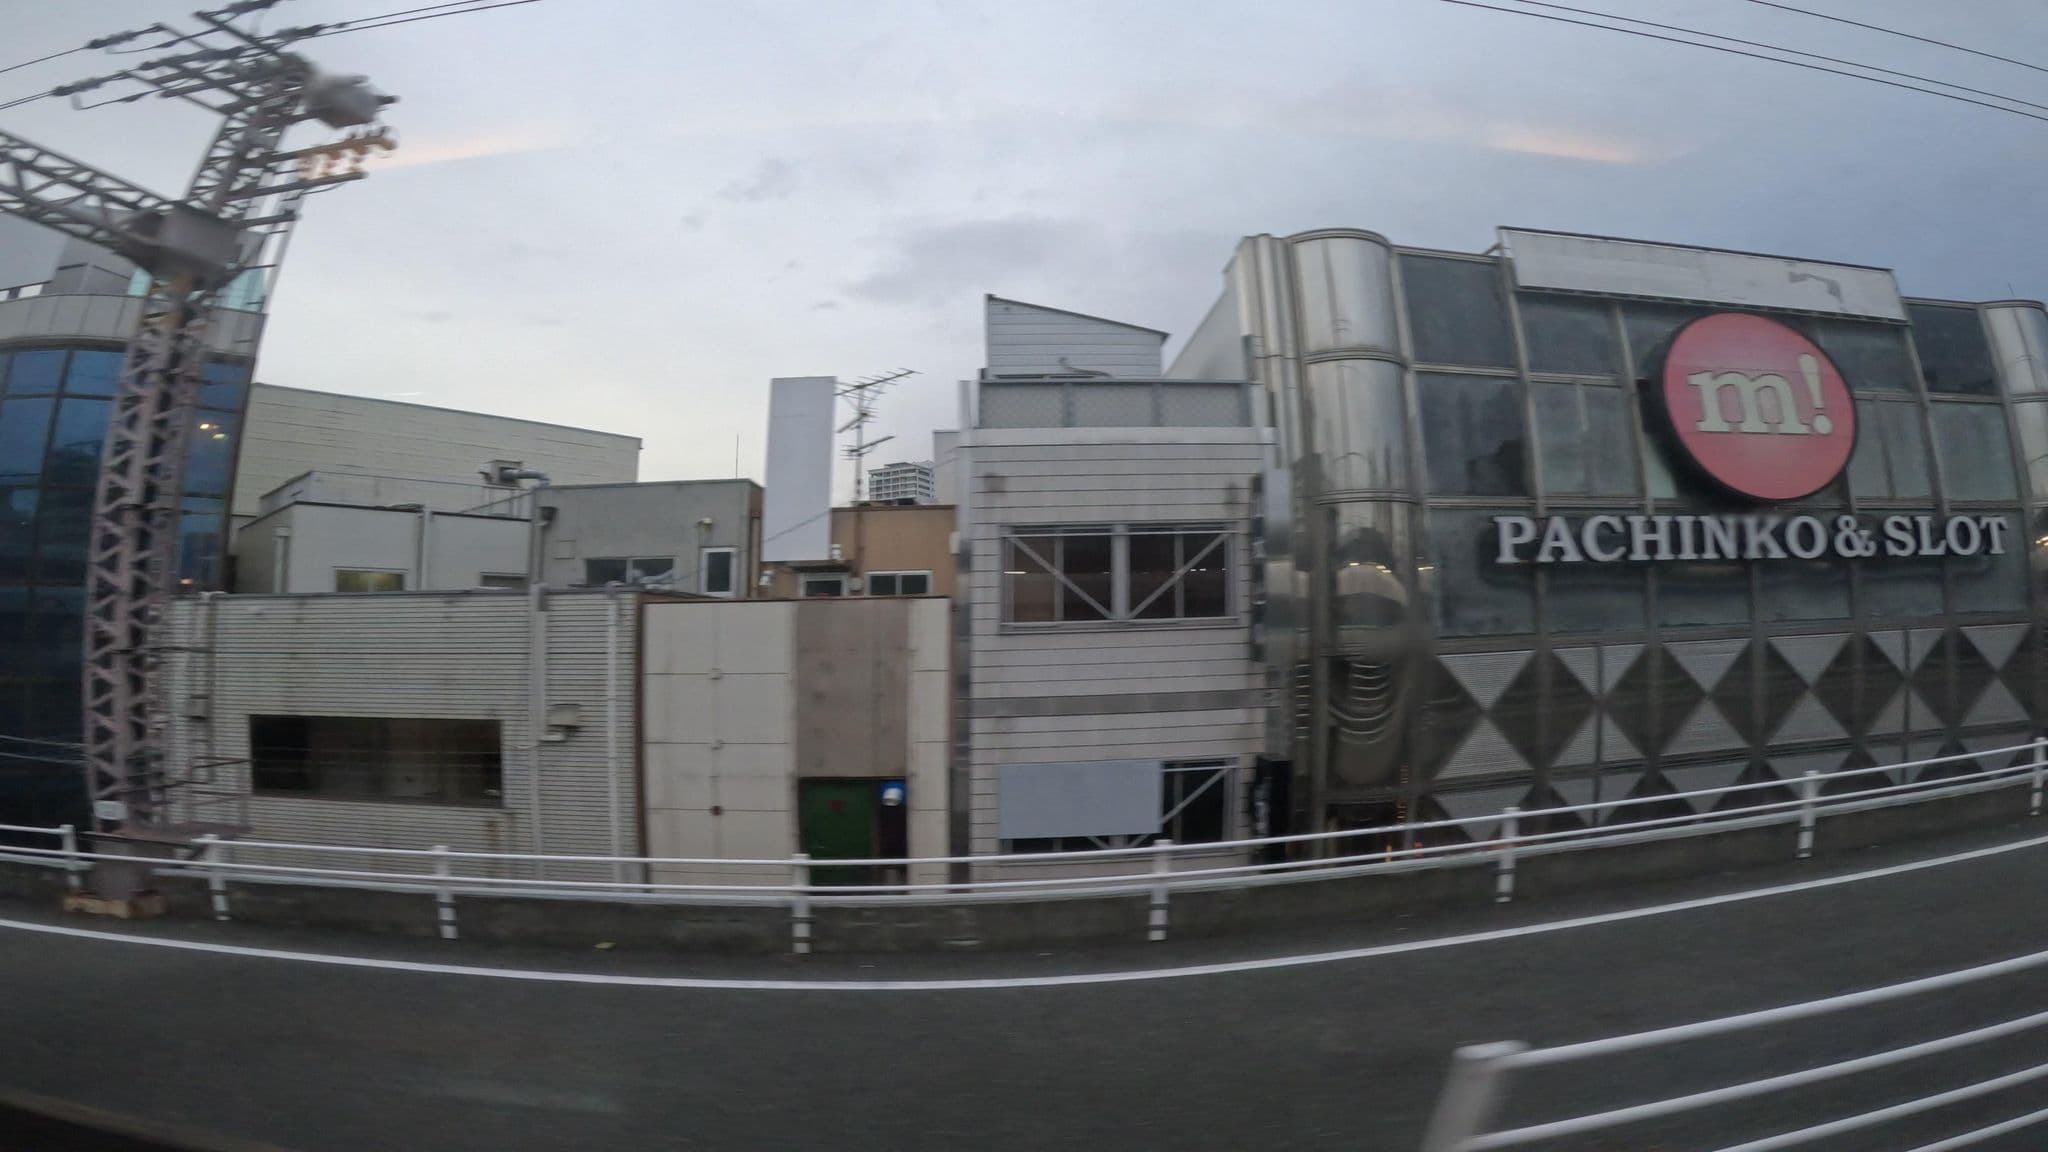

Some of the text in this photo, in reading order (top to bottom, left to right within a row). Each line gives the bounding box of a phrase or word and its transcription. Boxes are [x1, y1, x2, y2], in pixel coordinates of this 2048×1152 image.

[1687, 352, 1833, 435] m!
[1495, 515, 1828, 563] PACHINKO
[1884, 515, 2009, 557] SLOT
